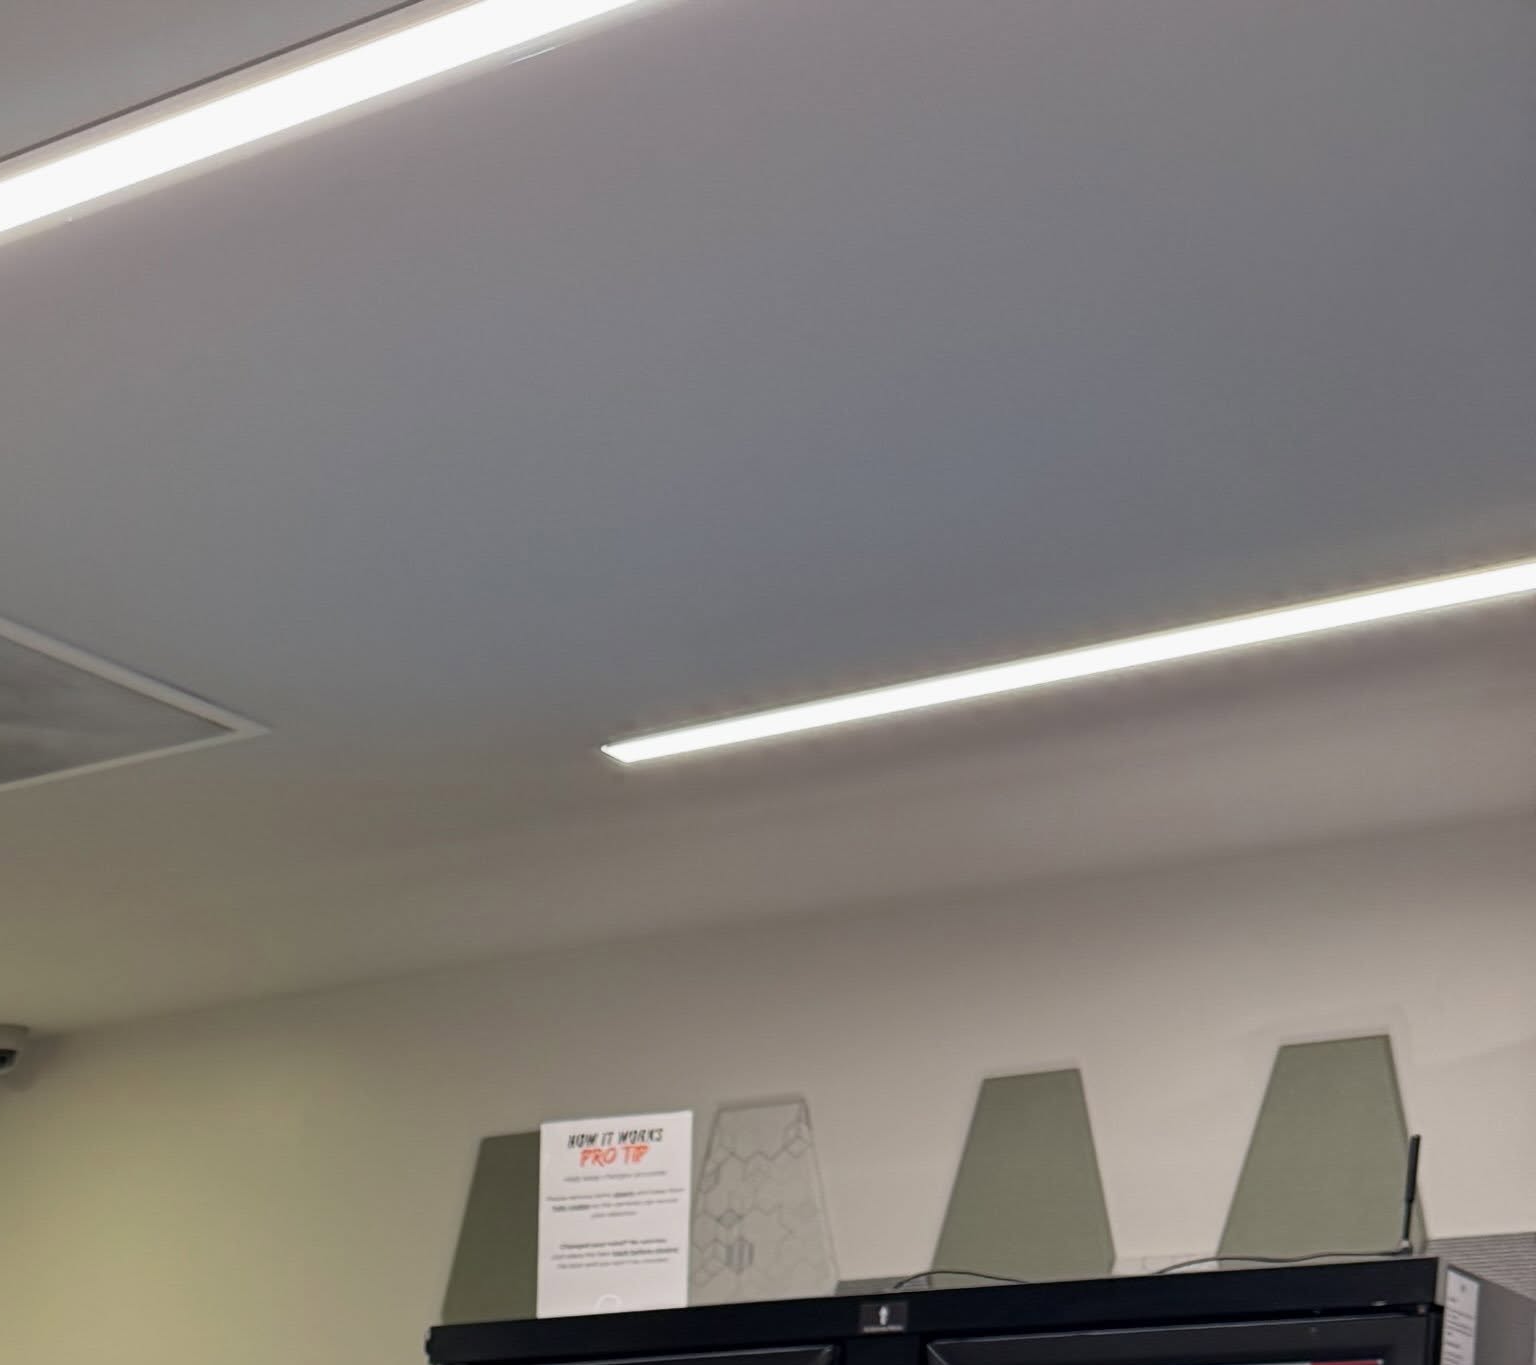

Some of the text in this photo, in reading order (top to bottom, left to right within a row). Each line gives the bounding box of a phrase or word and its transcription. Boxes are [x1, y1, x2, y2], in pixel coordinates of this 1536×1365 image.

[568, 1128, 663, 1149] HOW IT WORKS
[579, 1145, 649, 1167] PRO TIP
